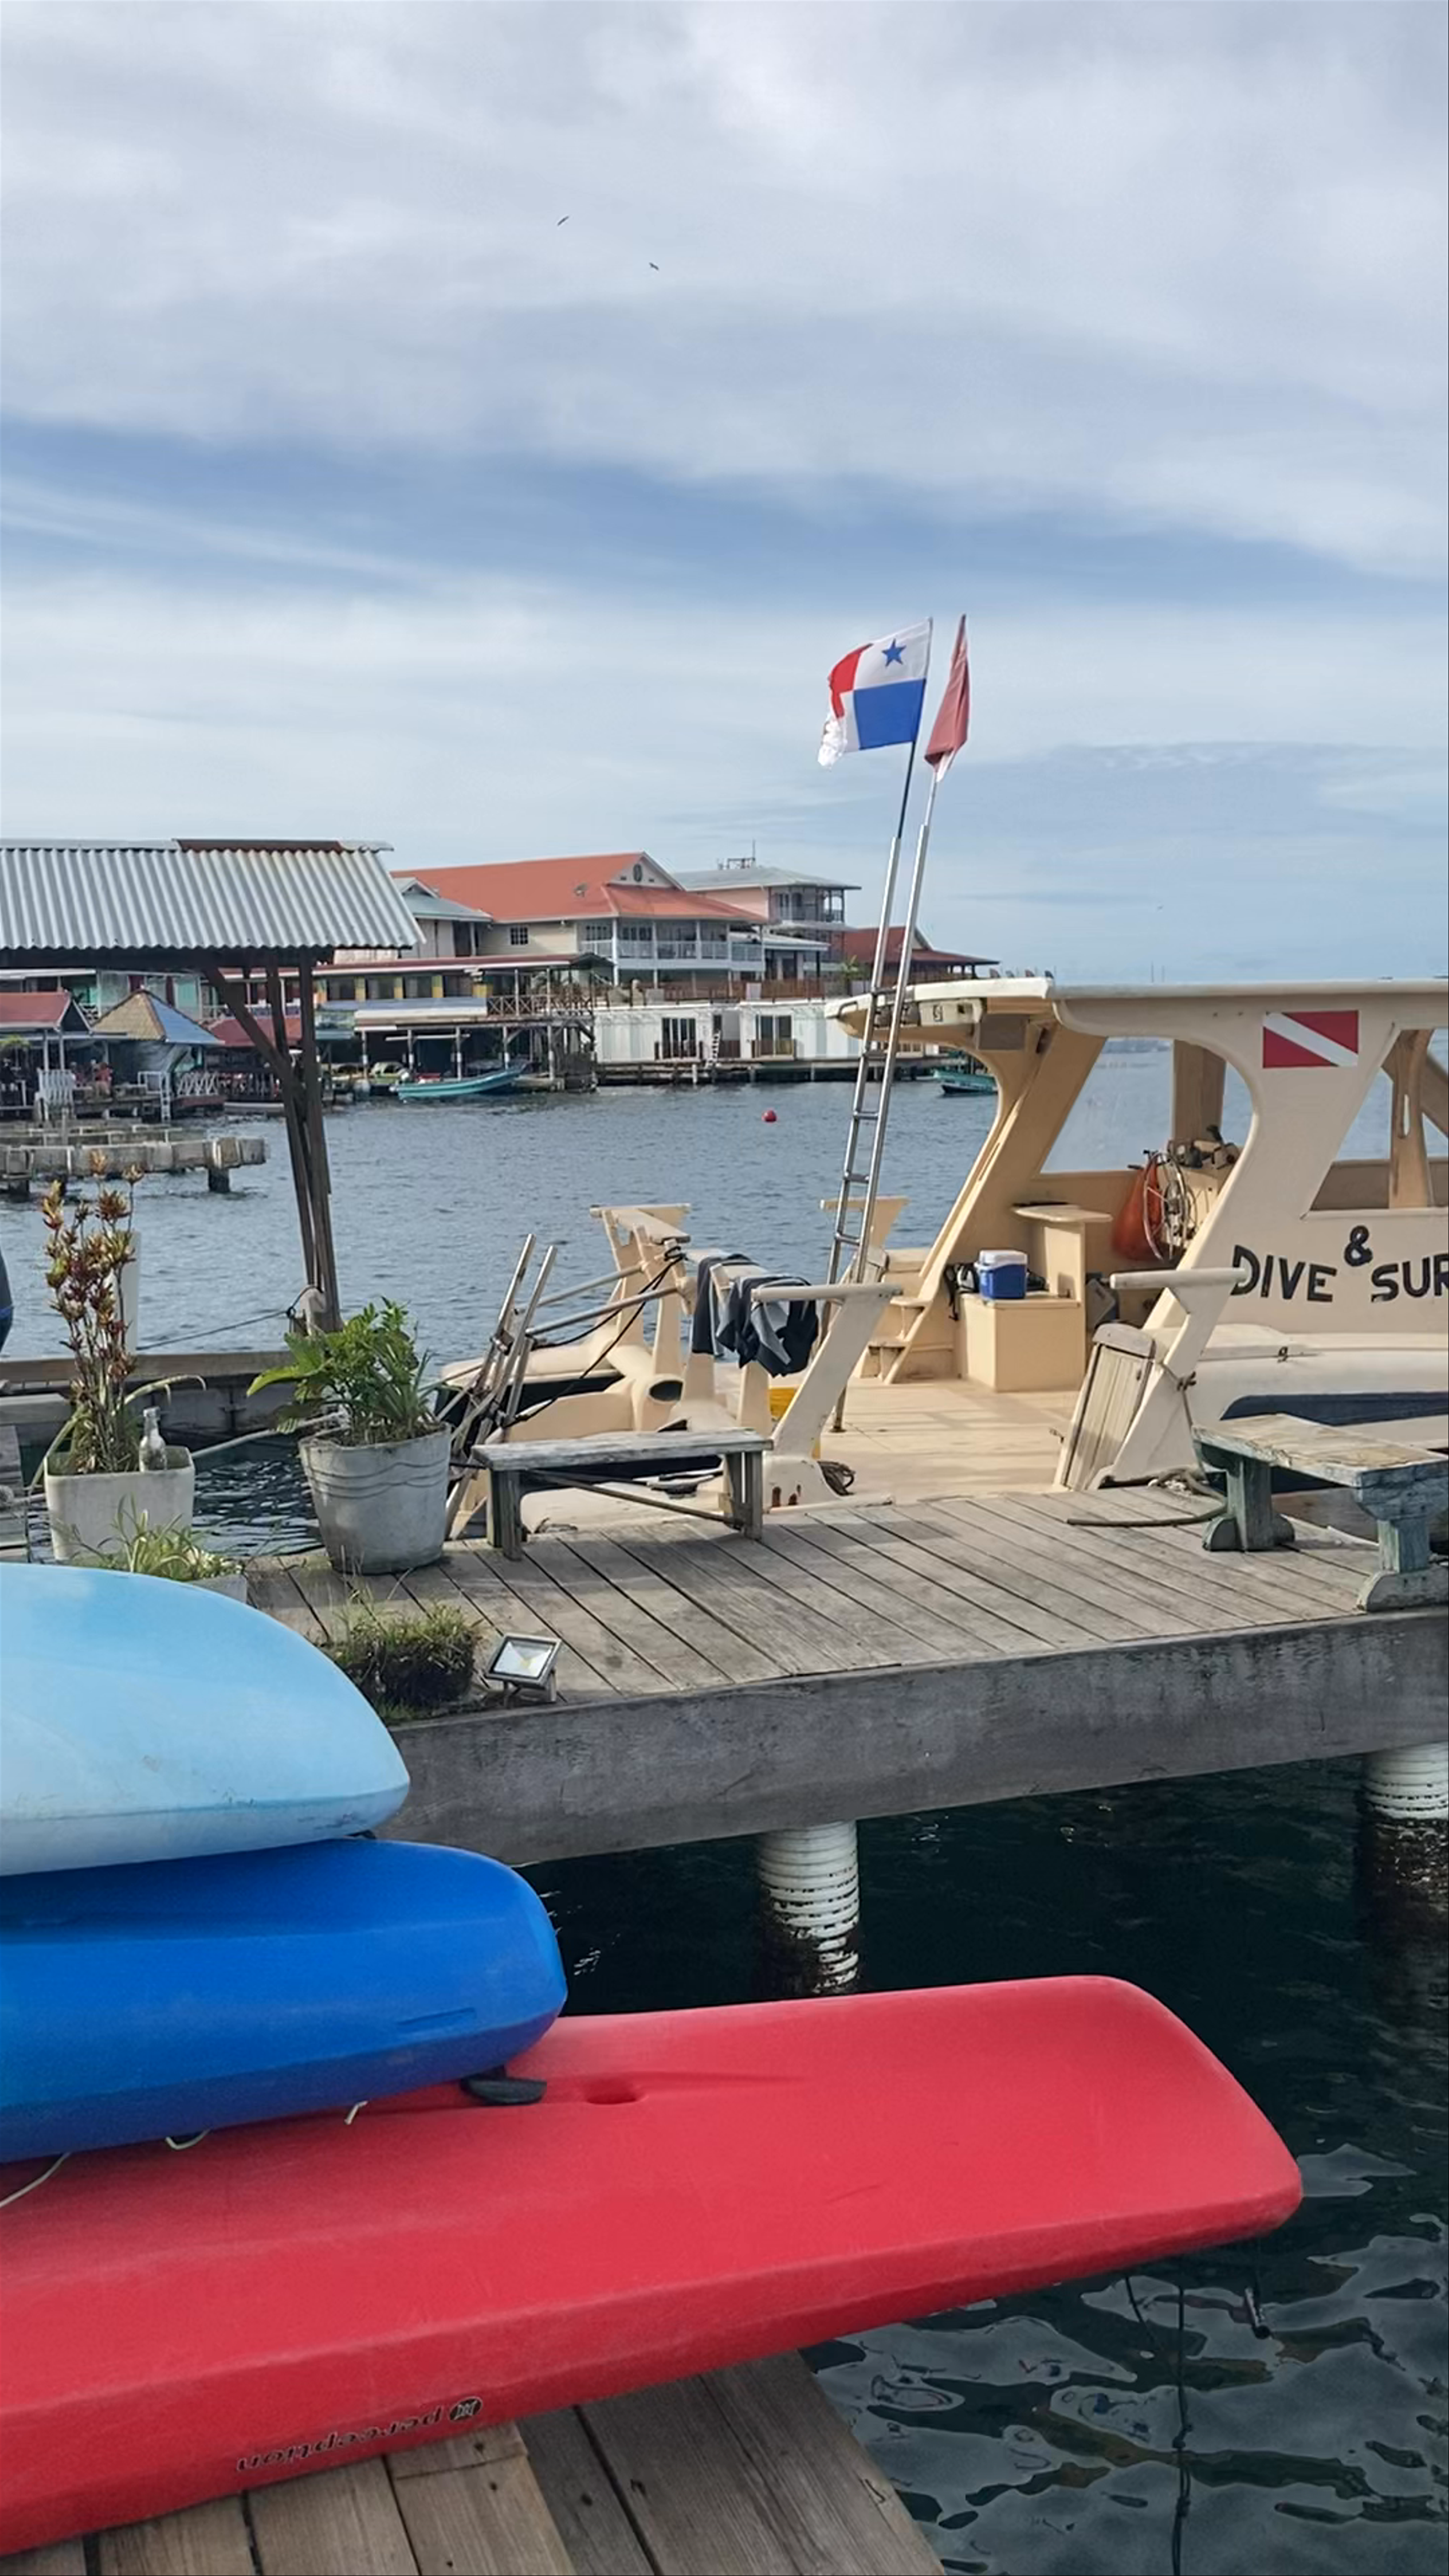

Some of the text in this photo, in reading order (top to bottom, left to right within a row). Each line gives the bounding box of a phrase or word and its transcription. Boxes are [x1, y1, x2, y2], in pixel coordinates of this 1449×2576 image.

[1230, 1244, 1337, 1303] DIVE
[1344, 1225, 1373, 1267] &
[237, 2405, 443, 2471] perception
